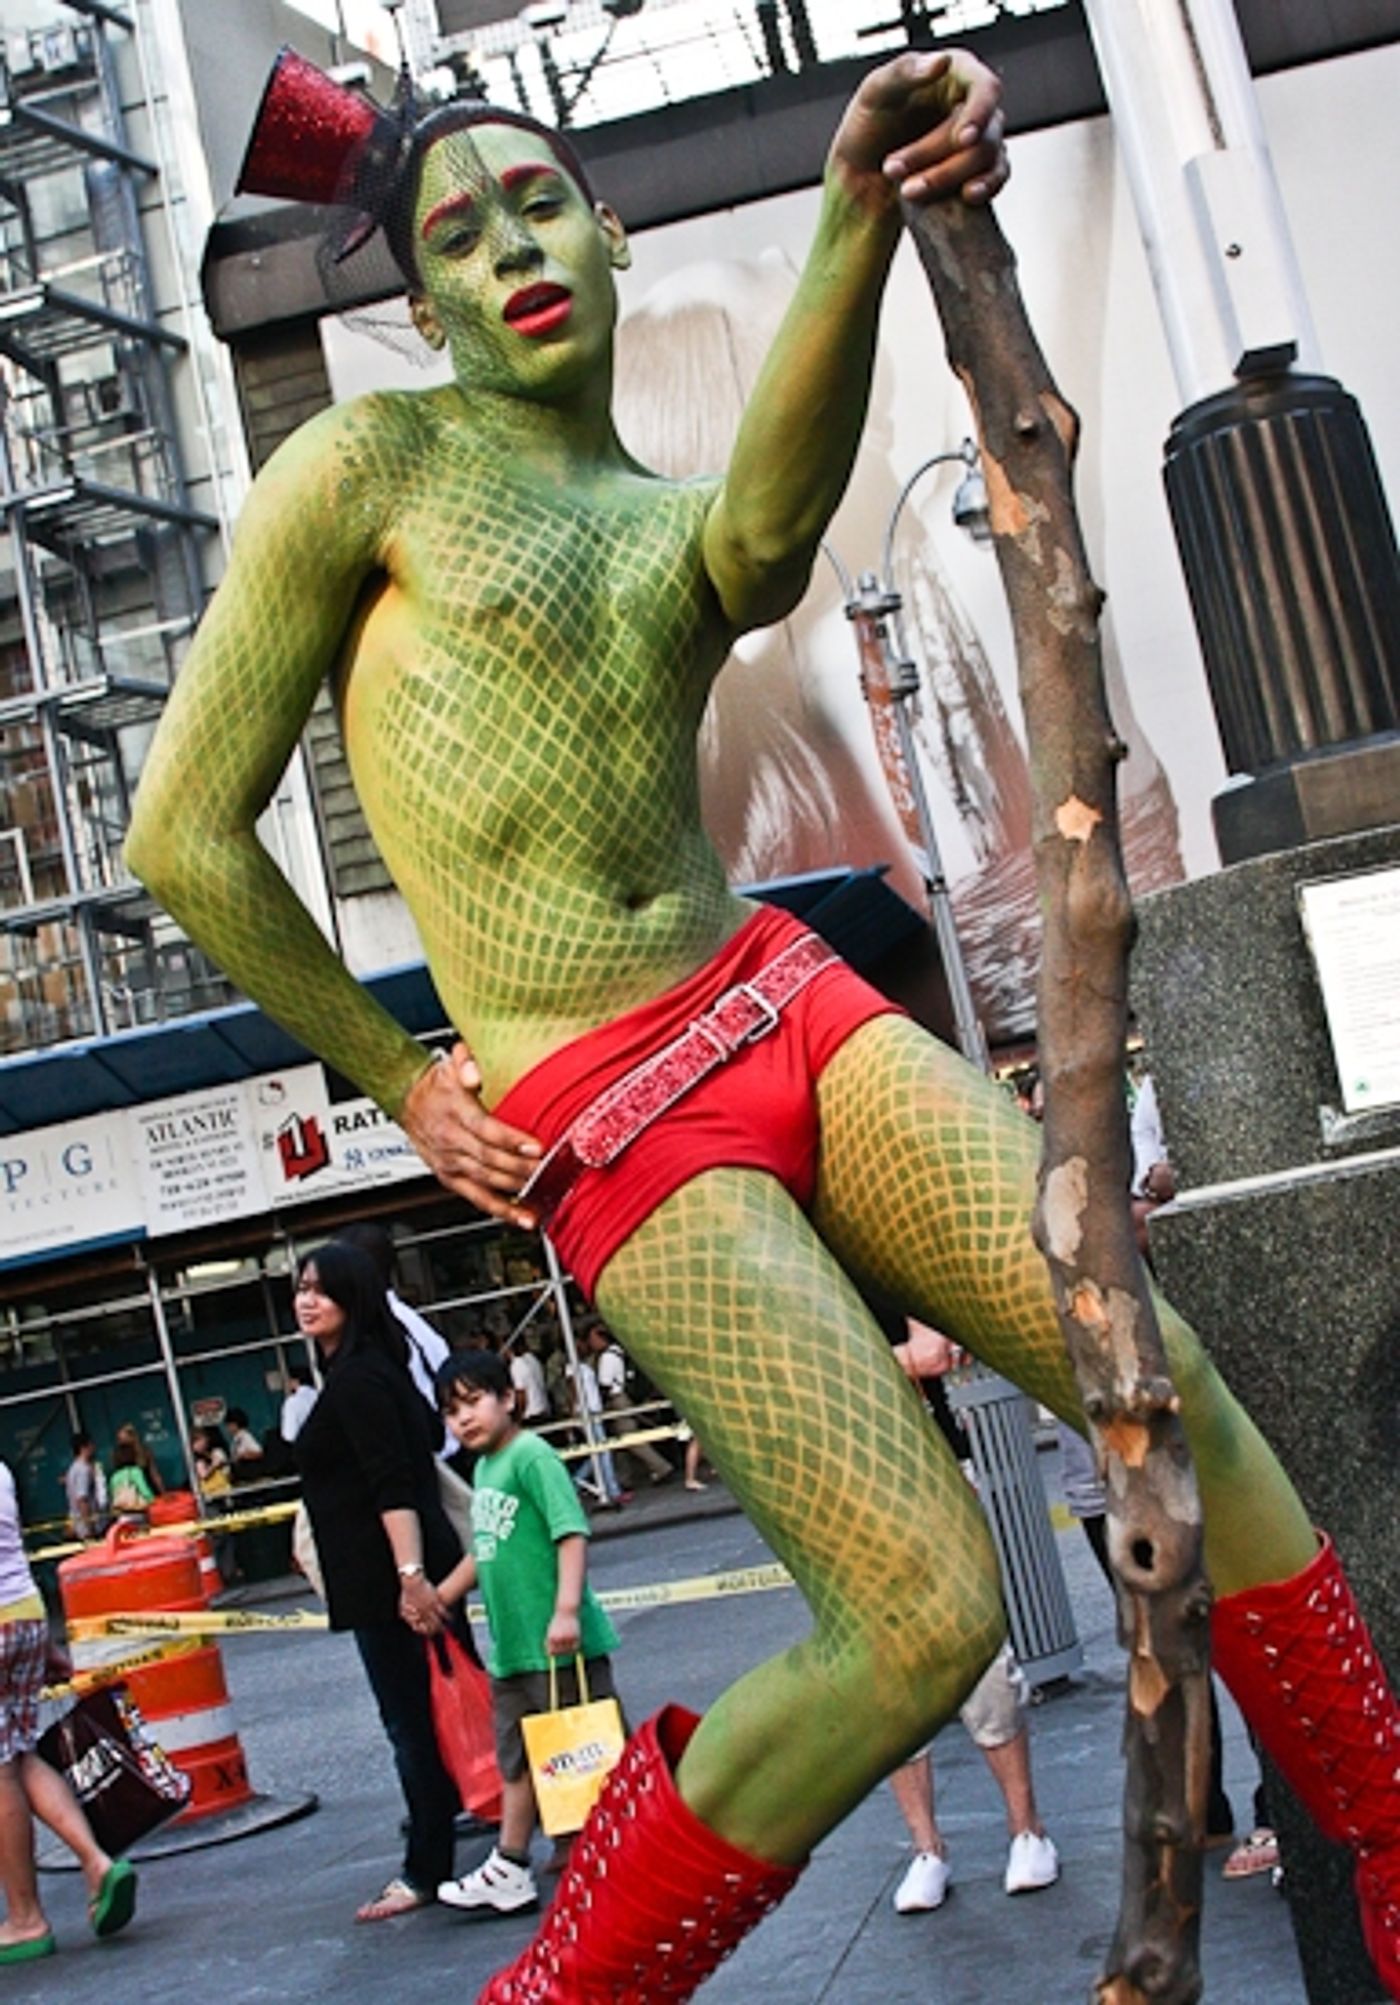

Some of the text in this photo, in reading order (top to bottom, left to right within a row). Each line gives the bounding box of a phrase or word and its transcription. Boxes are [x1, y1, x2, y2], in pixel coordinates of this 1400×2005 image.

[145, 1108, 238, 1146] ATLANTIC
[2, 1142, 93, 1193] P G
